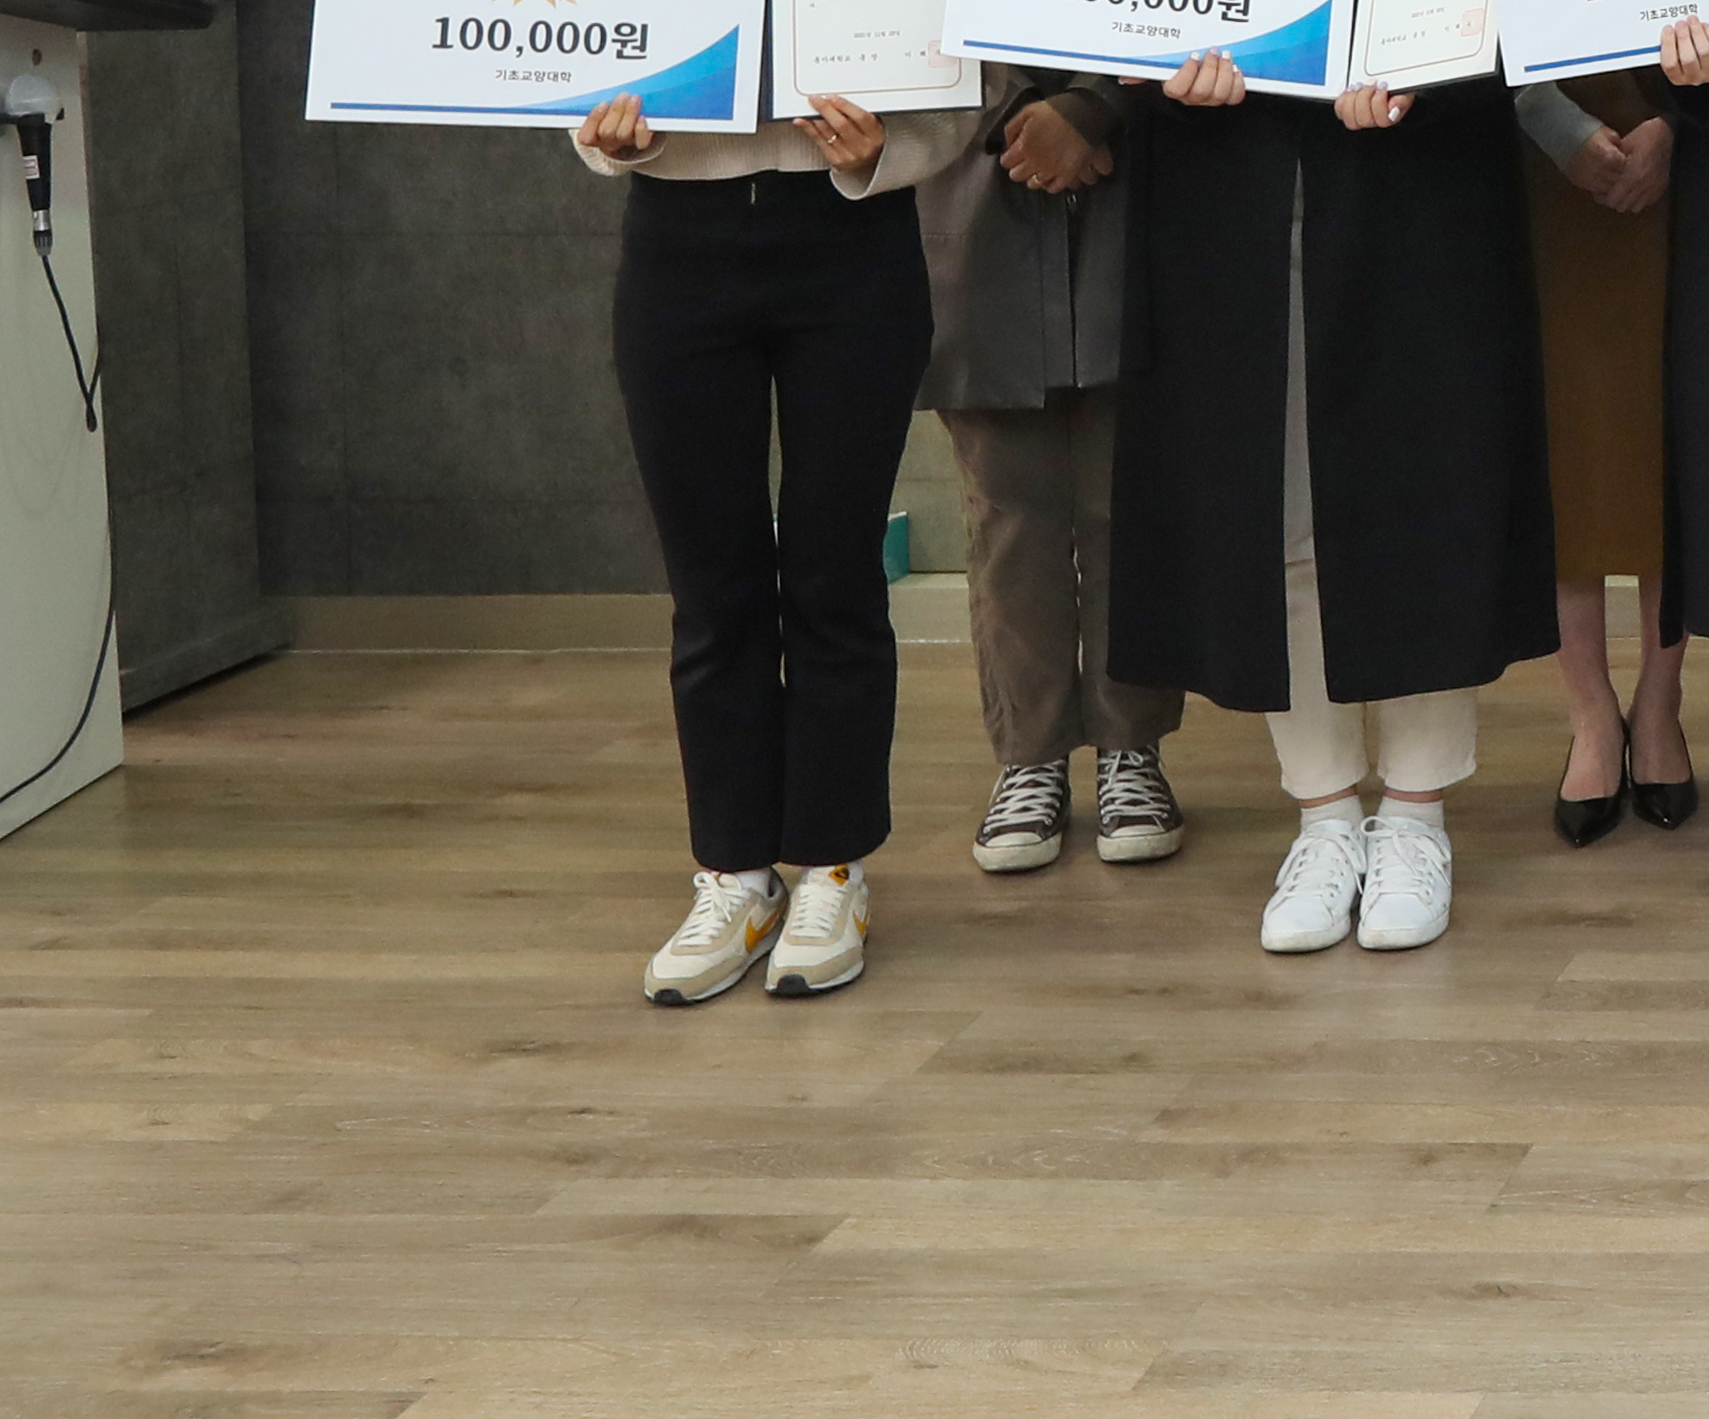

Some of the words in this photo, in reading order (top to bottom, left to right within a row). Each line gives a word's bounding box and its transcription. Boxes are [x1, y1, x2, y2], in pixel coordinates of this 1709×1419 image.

[1639, 3, 1699, 22] 기초교양대학
[431, 16, 649, 61] 100,000원
[1111, 21, 1181, 40] 기초교양대학
[495, 69, 573, 84] 기초교양대학
